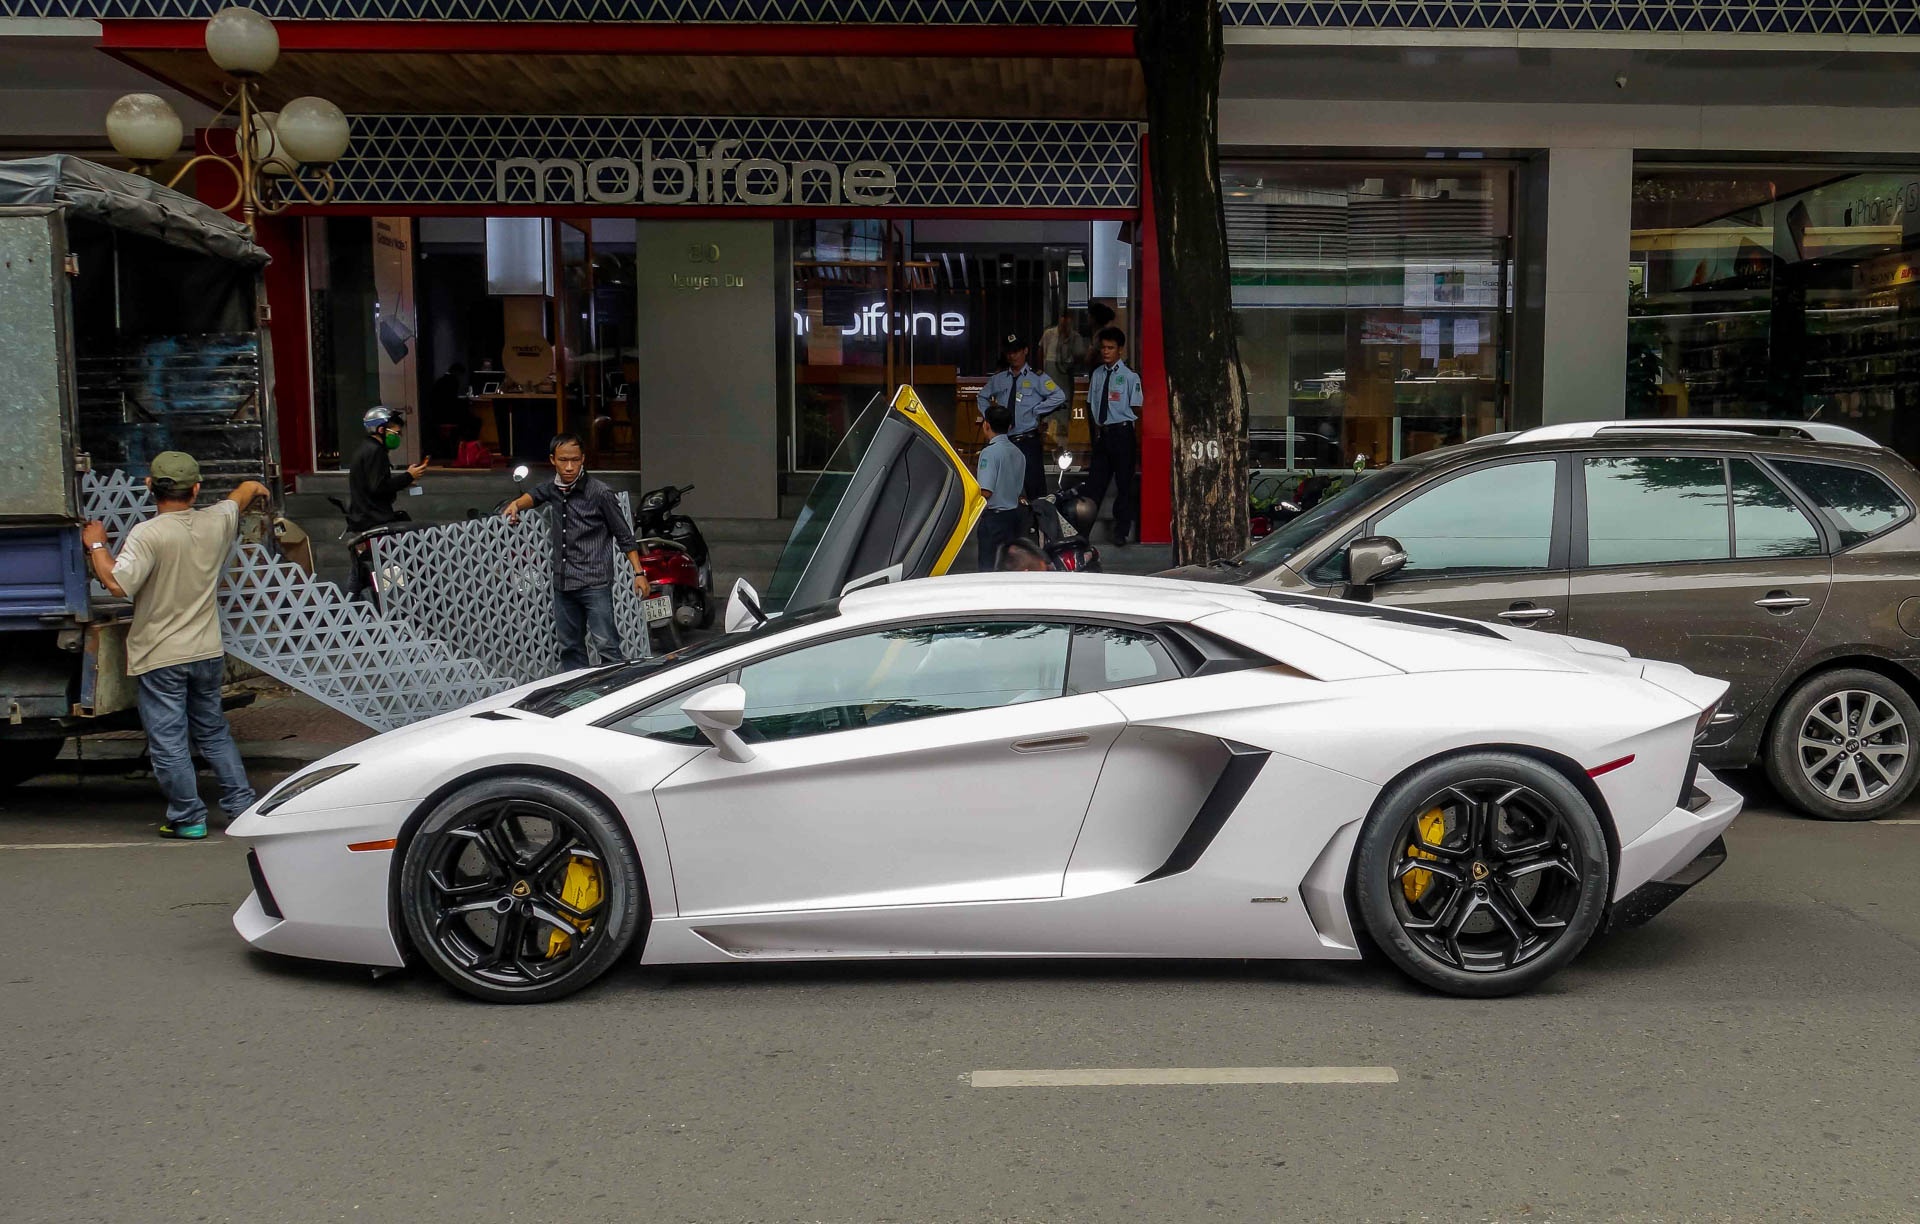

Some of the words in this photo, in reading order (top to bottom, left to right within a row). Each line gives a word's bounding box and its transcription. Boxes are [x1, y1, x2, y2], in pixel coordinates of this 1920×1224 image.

[495, 138, 897, 206] mobifone
[1855, 197, 1893, 225] iPhone
[1073, 407, 1085, 420] 11
[1191, 440, 1218, 459] 96
